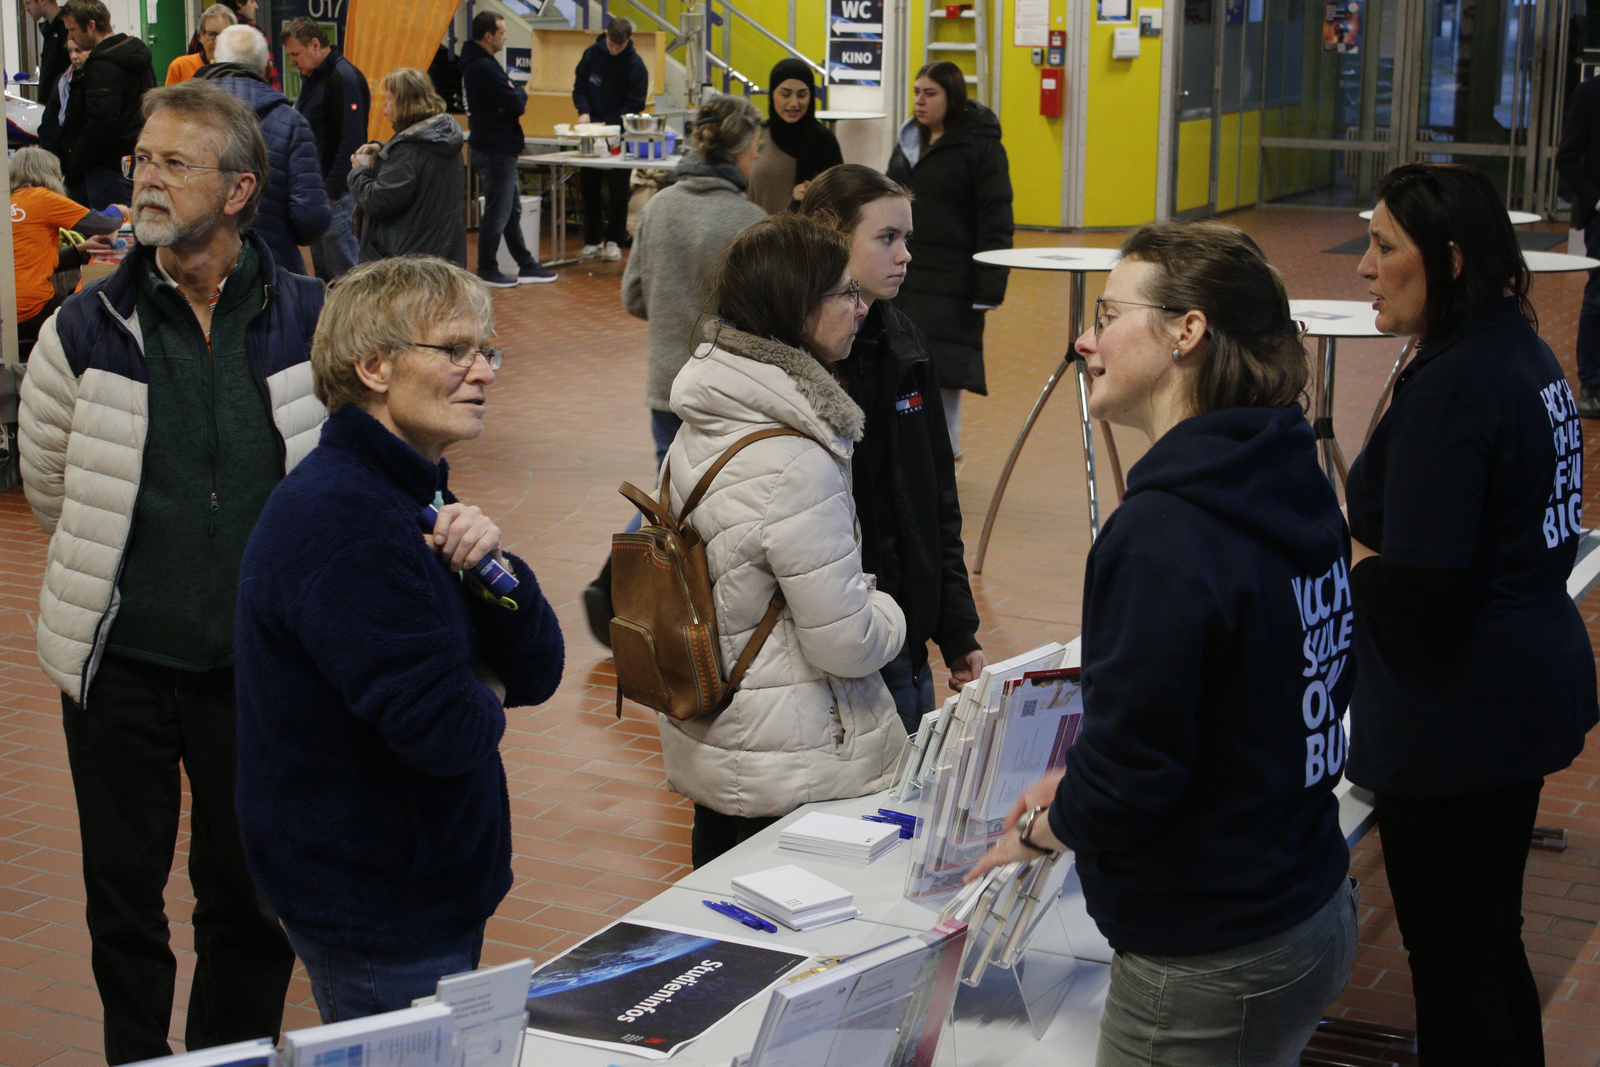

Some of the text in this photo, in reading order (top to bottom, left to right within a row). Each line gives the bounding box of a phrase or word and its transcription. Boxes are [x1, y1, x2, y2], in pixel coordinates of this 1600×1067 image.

[841, 1, 872, 19] WC
[515, 57, 532, 68] KIN
[841, 51, 873, 65] KINO
[896, 391, 918, 401] TOMMY
[617, 959, 723, 1023] Studieninfos
